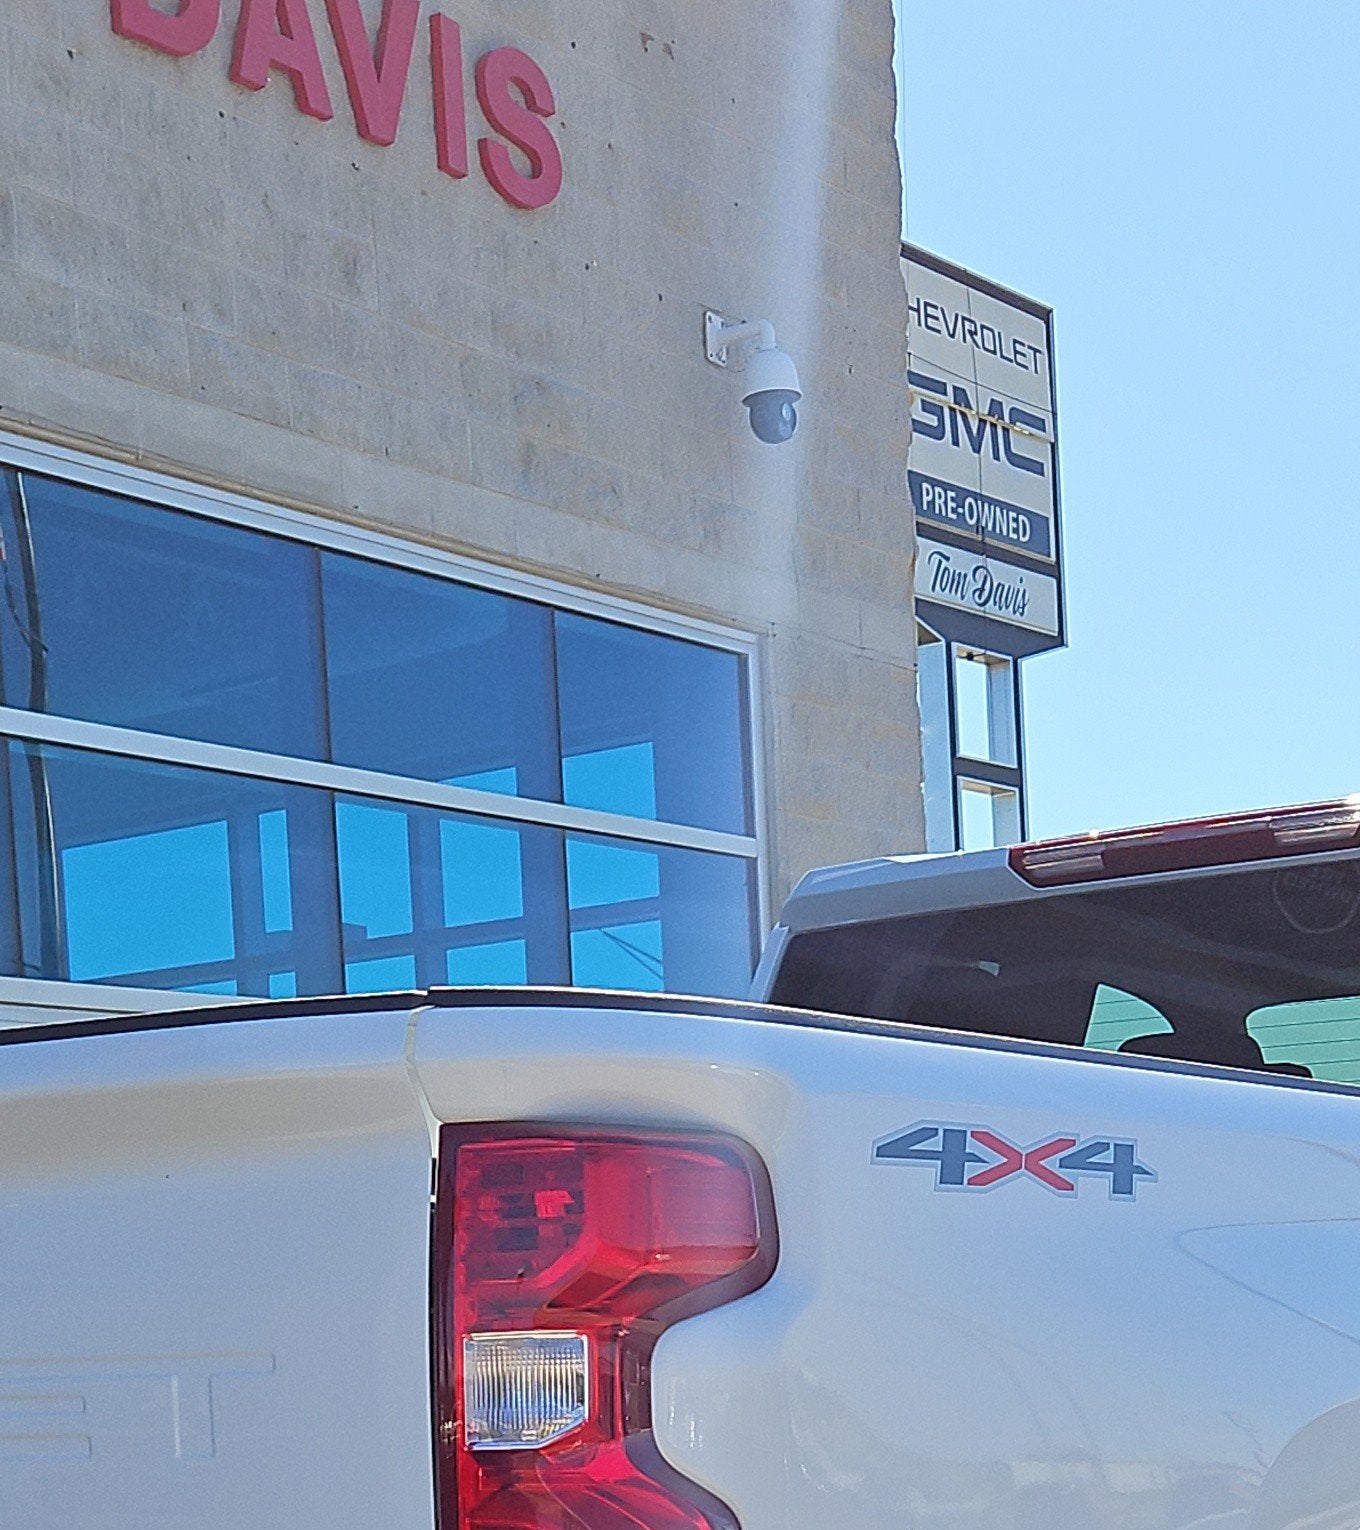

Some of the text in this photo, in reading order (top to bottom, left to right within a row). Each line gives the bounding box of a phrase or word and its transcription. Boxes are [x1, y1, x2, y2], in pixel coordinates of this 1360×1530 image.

[907, 297, 1043, 375] HEVROLET
[907, 369, 1047, 477] GMC
[921, 482, 1031, 543] PRE-OWNED
[927, 551, 1029, 617] Tom Davis
[873, 1123, 1156, 1199] 4X4
